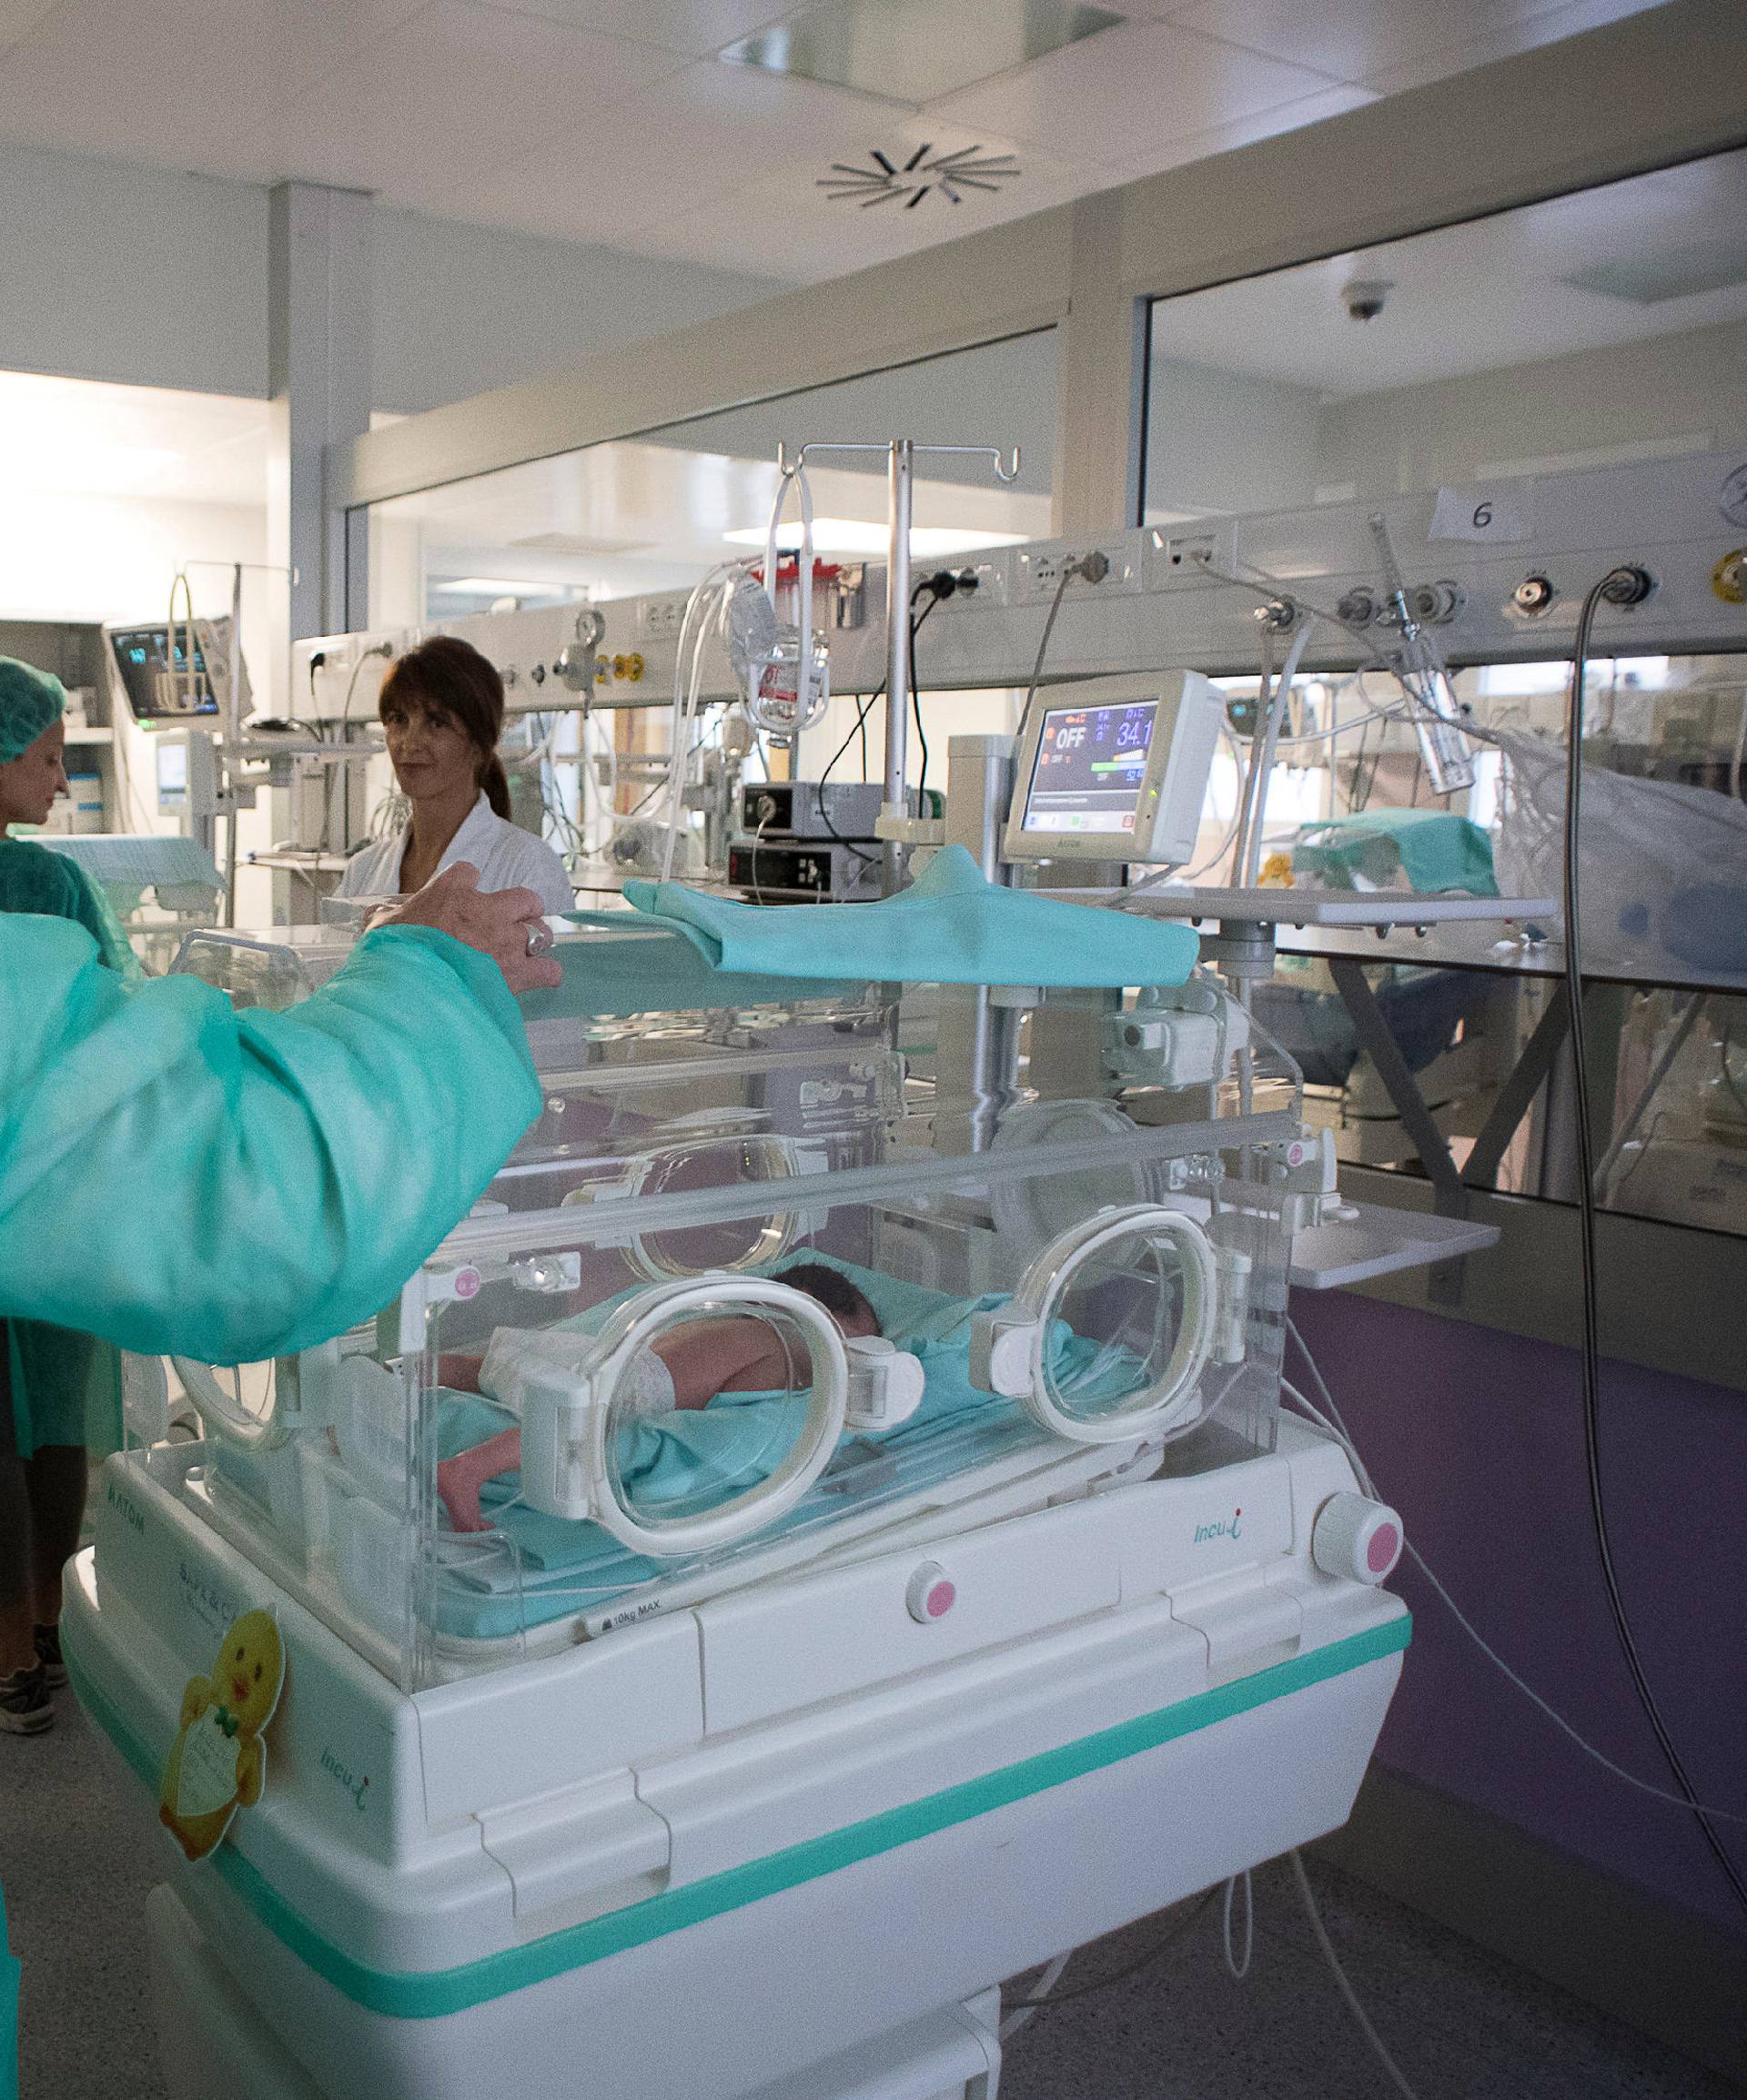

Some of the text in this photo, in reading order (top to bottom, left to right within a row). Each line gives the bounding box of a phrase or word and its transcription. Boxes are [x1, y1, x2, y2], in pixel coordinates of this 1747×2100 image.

[1473, 501, 1492, 528] 6
[1055, 726, 1087, 750] OFF
[613, 1600, 661, 1624] 10kg MAX
